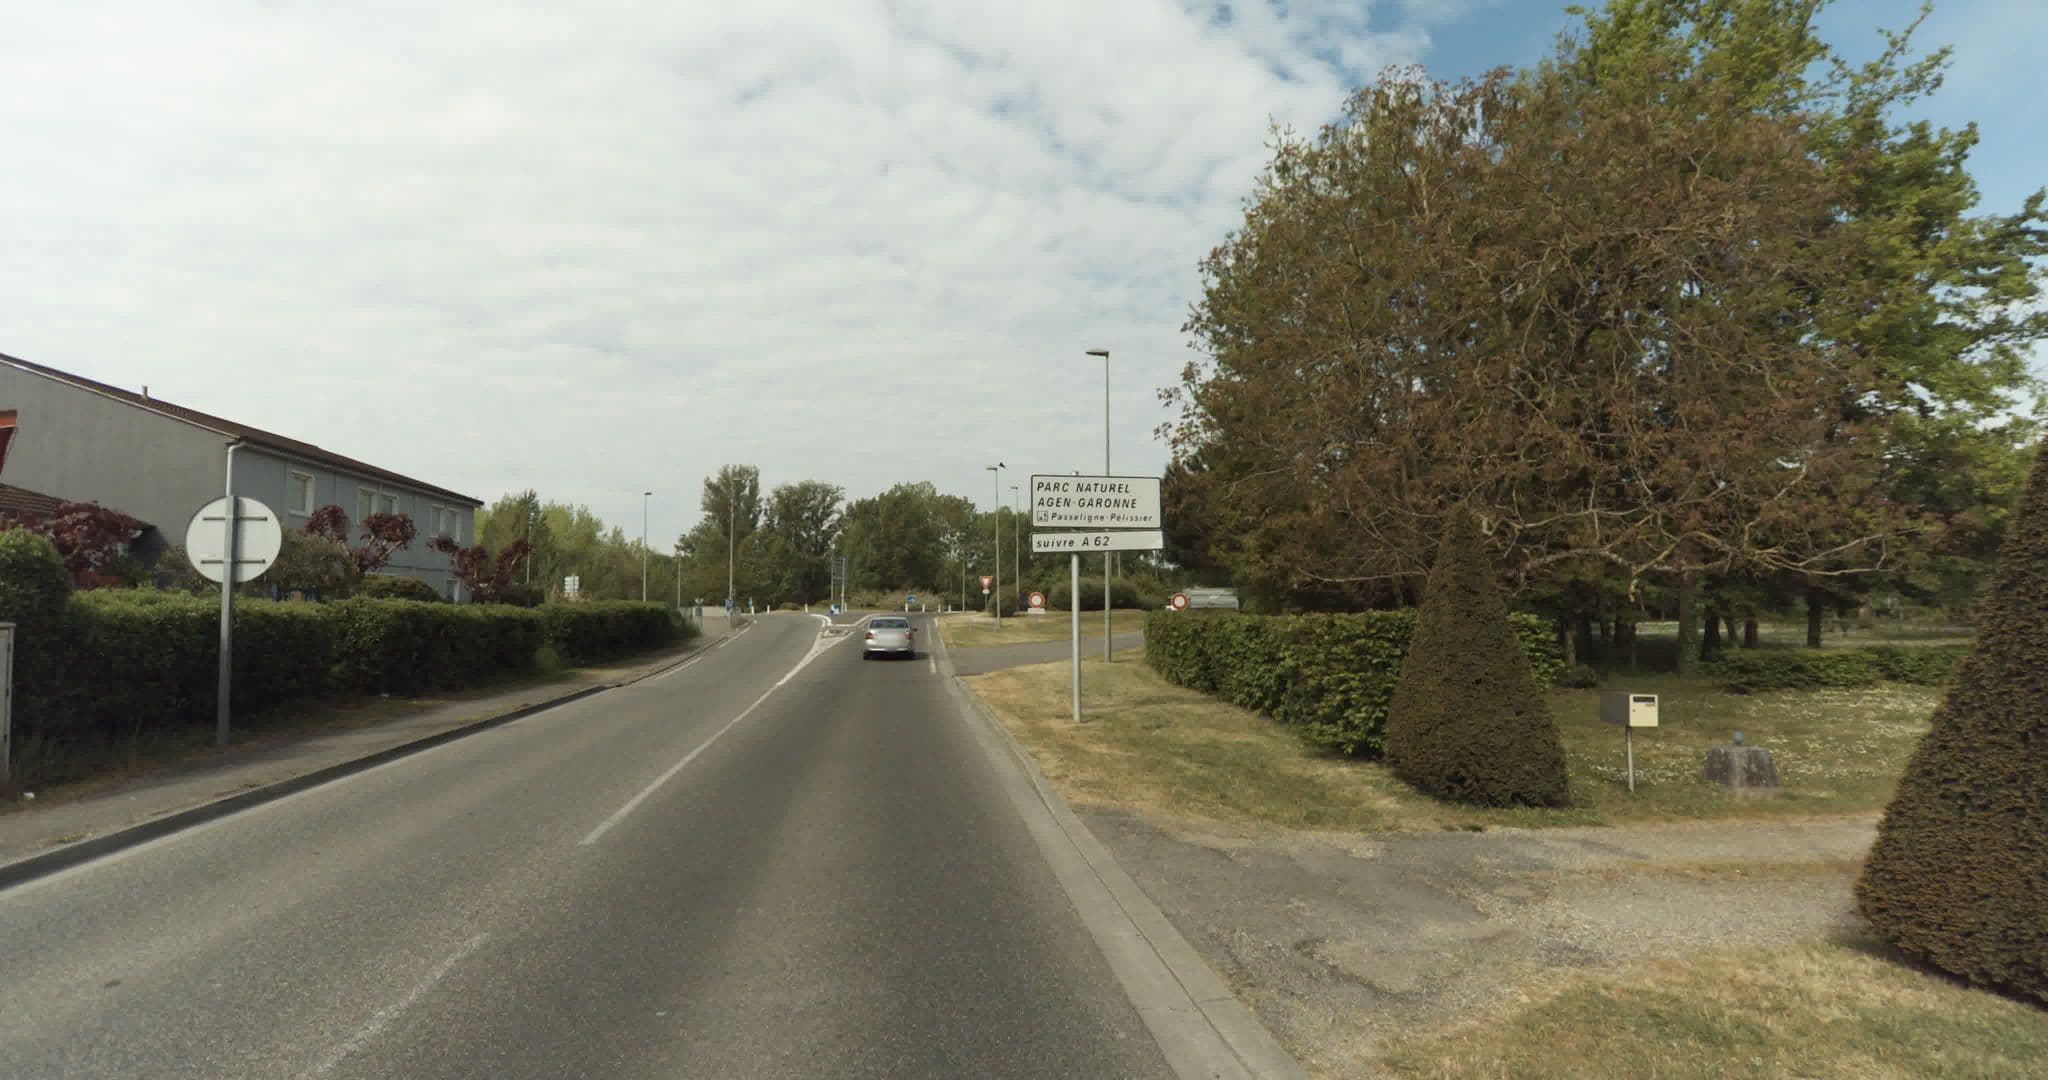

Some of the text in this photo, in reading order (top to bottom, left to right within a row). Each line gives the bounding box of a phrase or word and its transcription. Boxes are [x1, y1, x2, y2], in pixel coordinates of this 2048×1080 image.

[1036, 482, 1131, 494] PARC NATUREL
[1036, 536, 1111, 549] suivre A 62
